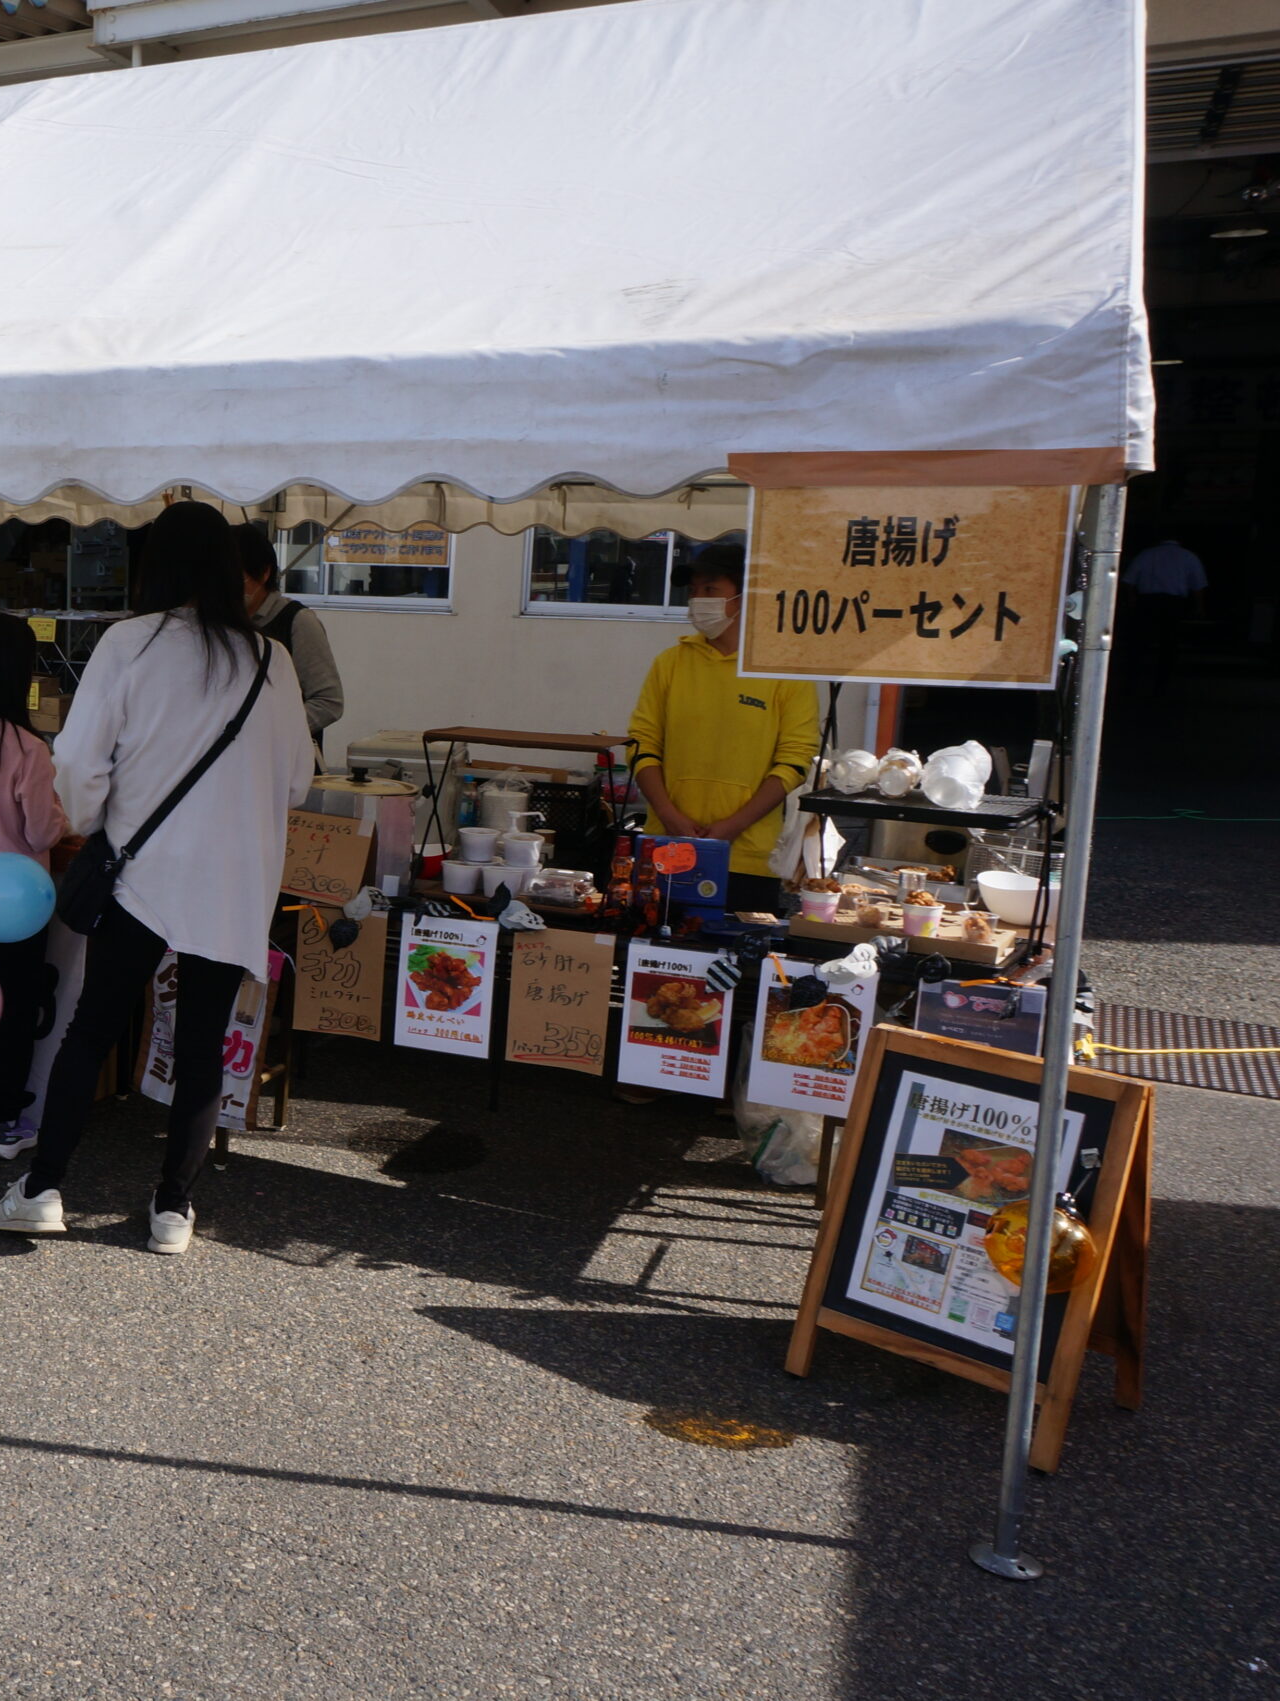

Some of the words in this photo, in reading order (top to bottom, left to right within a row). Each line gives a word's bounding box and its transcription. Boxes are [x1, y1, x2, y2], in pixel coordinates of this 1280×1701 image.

[842, 515, 960, 567] 唐揚げ
[775, 588, 1022, 642] 100パーセント
[301, 949, 361, 988] オカ
[521, 950, 590, 975] 砂肝の
[310, 986, 370, 1003] ミルクティー
[525, 978, 589, 1007] 唐揚げ
[910, 1092, 1032, 1137] 唐揚げ100%
